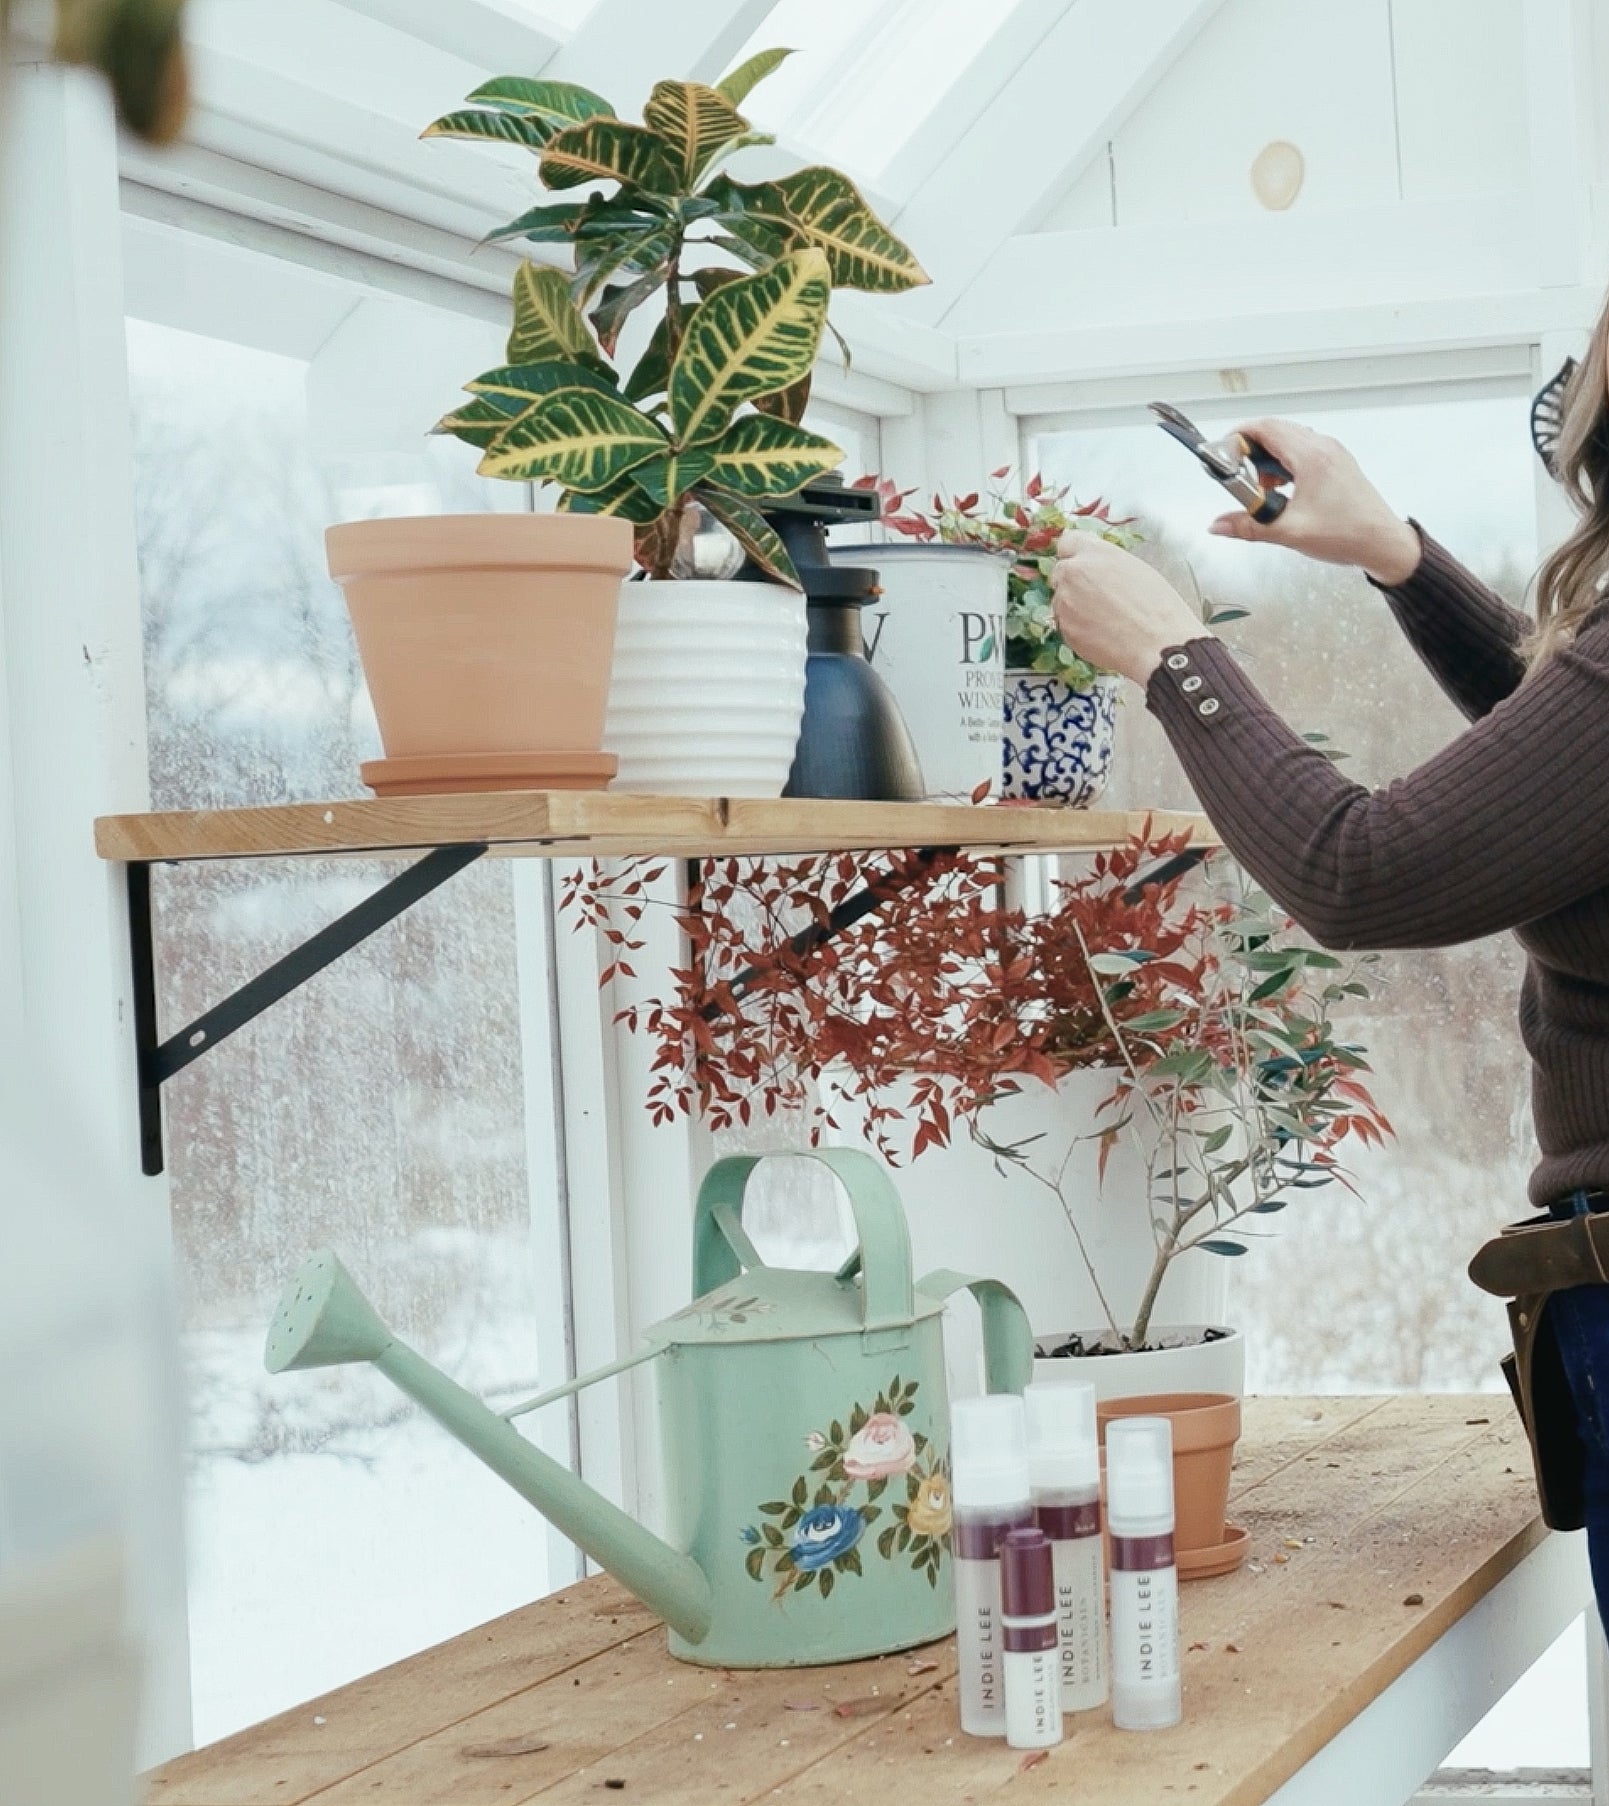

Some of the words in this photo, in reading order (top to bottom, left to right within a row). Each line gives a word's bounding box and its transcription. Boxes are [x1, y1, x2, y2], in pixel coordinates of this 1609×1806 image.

[1059, 1585, 1073, 1620] LEE
[1137, 1575, 1151, 1611] LEE
[978, 1607, 992, 1642] LEE
[1033, 1656, 1043, 1682] LEE
[1061, 1628, 1075, 1685] INDIE
[1139, 1621, 1152, 1680] INDIE
[980, 1651, 994, 1709] INDIE
[1034, 1689, 1045, 1734] INDIE
